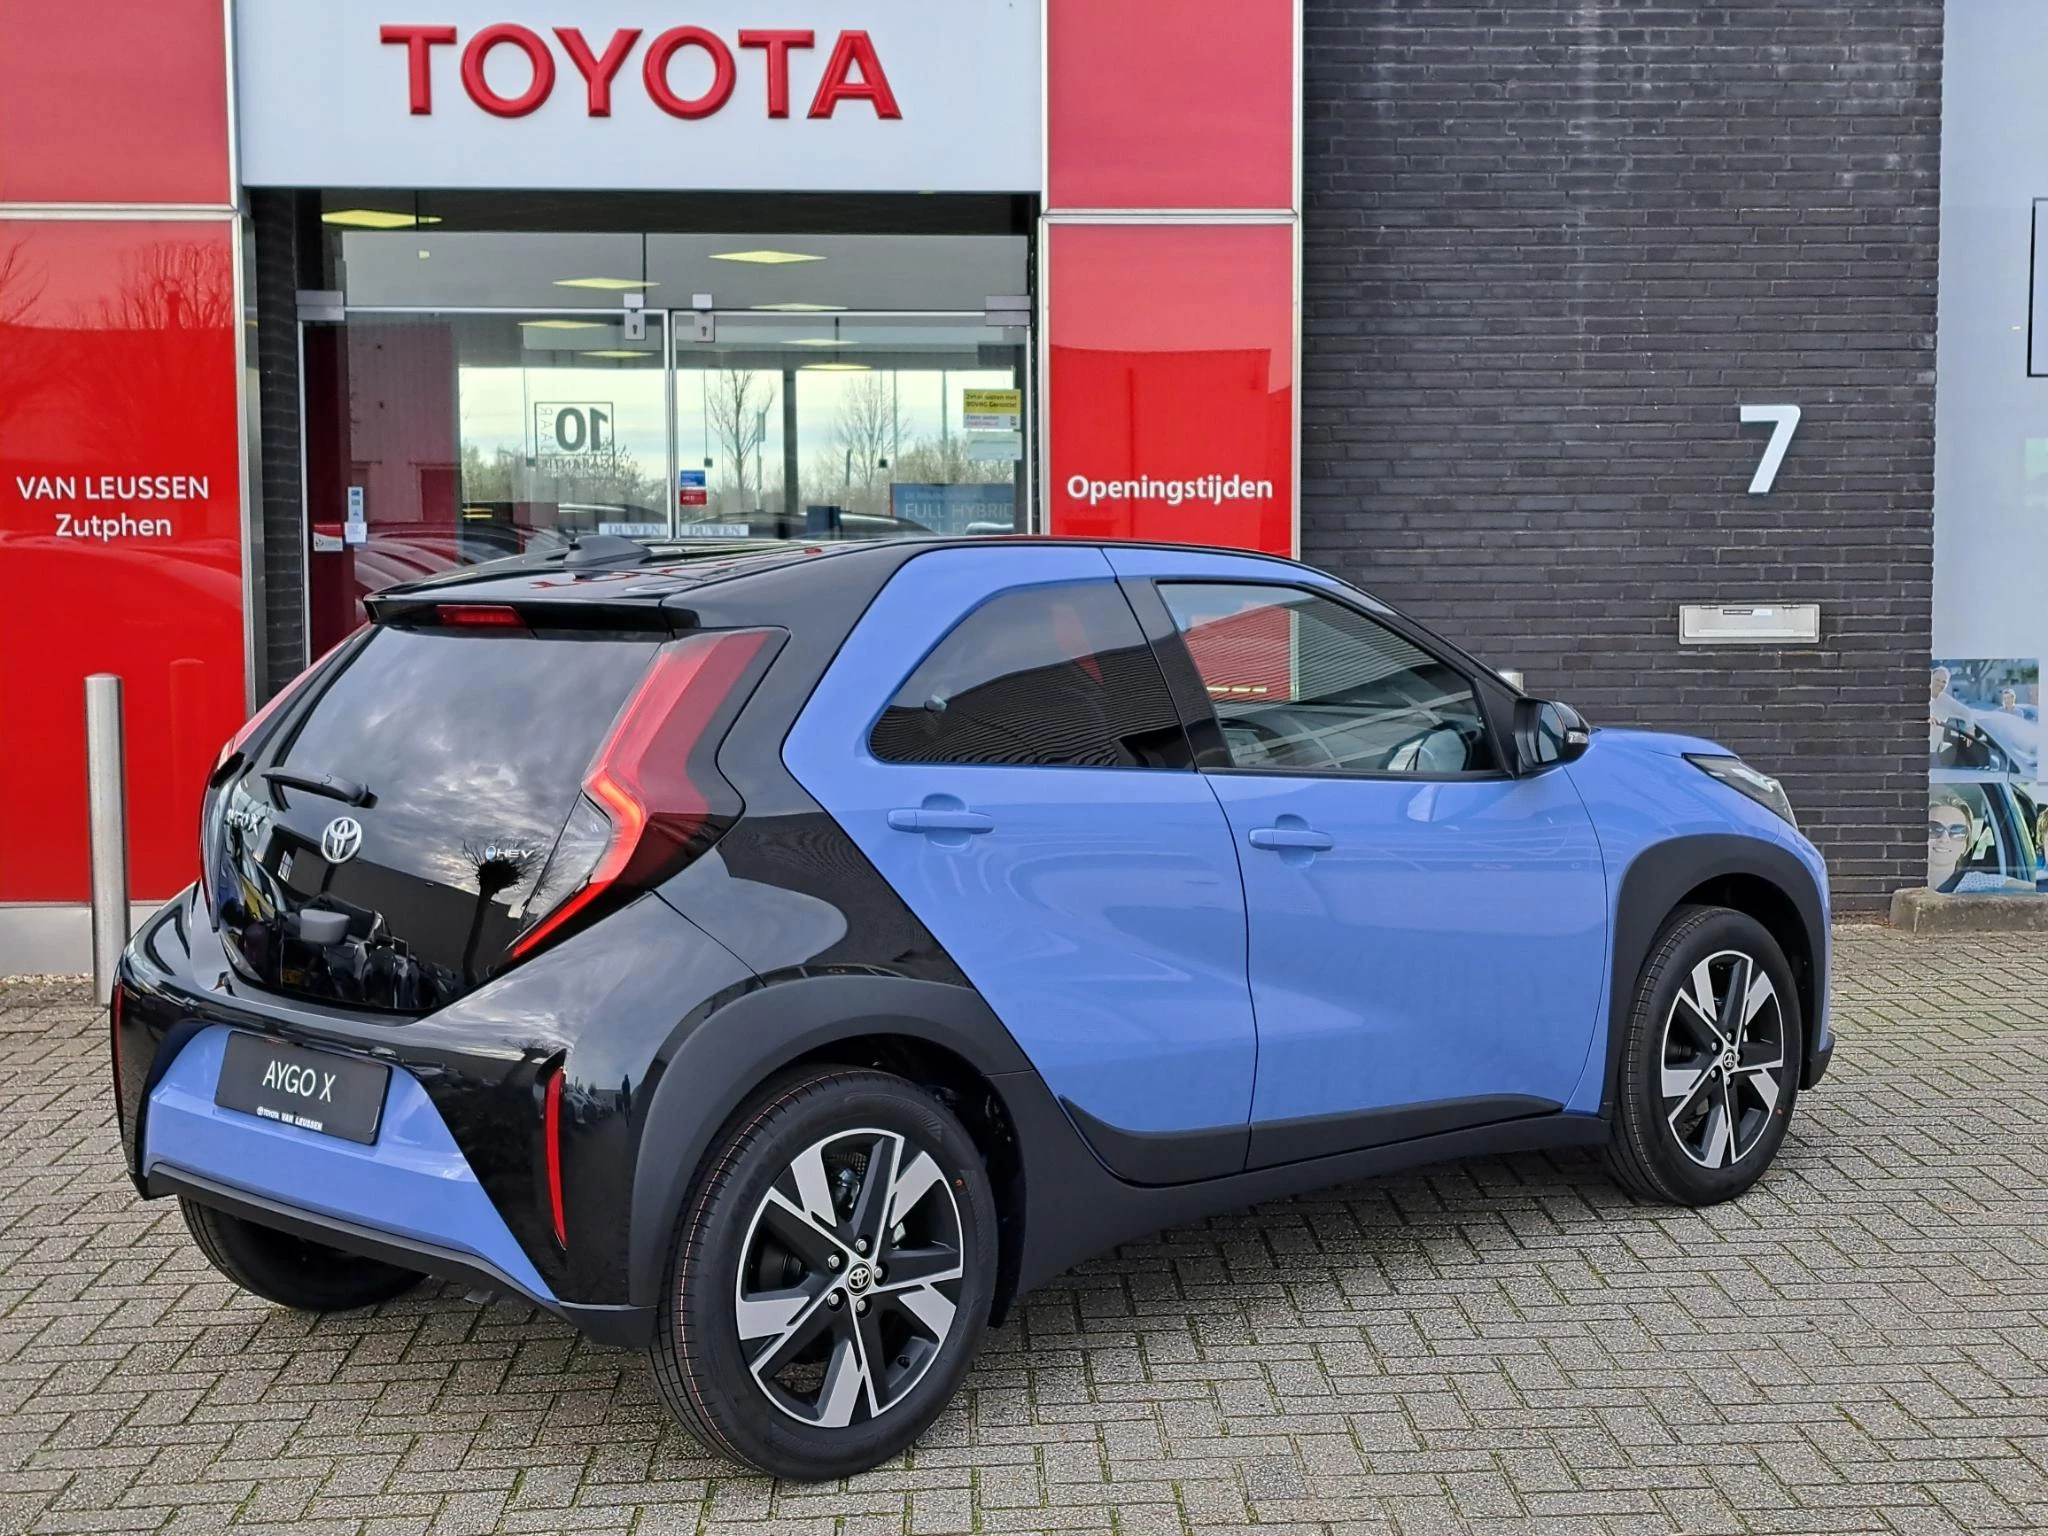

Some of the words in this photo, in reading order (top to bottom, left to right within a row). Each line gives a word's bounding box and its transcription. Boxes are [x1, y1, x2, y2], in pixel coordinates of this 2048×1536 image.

[380, 23, 902, 120] TOYOTA
[1740, 405, 1801, 493] 7
[16, 476, 76, 500] VAN
[85, 476, 209, 500] LEUSSEN
[1067, 475, 1273, 505] Openingstijden
[905, 503, 945, 519] FULL
[55, 512, 171, 542] Zutphen
[608, 524, 661, 535] DUWEN
[689, 525, 741, 536] DUWEN
[496, 848, 535, 859] HEV
[262, 1060, 316, 1097] AYGO
[319, 1072, 336, 1103] X
[281, 1112, 294, 1124] VAN
[295, 1115, 323, 1131] LEUSSEN
